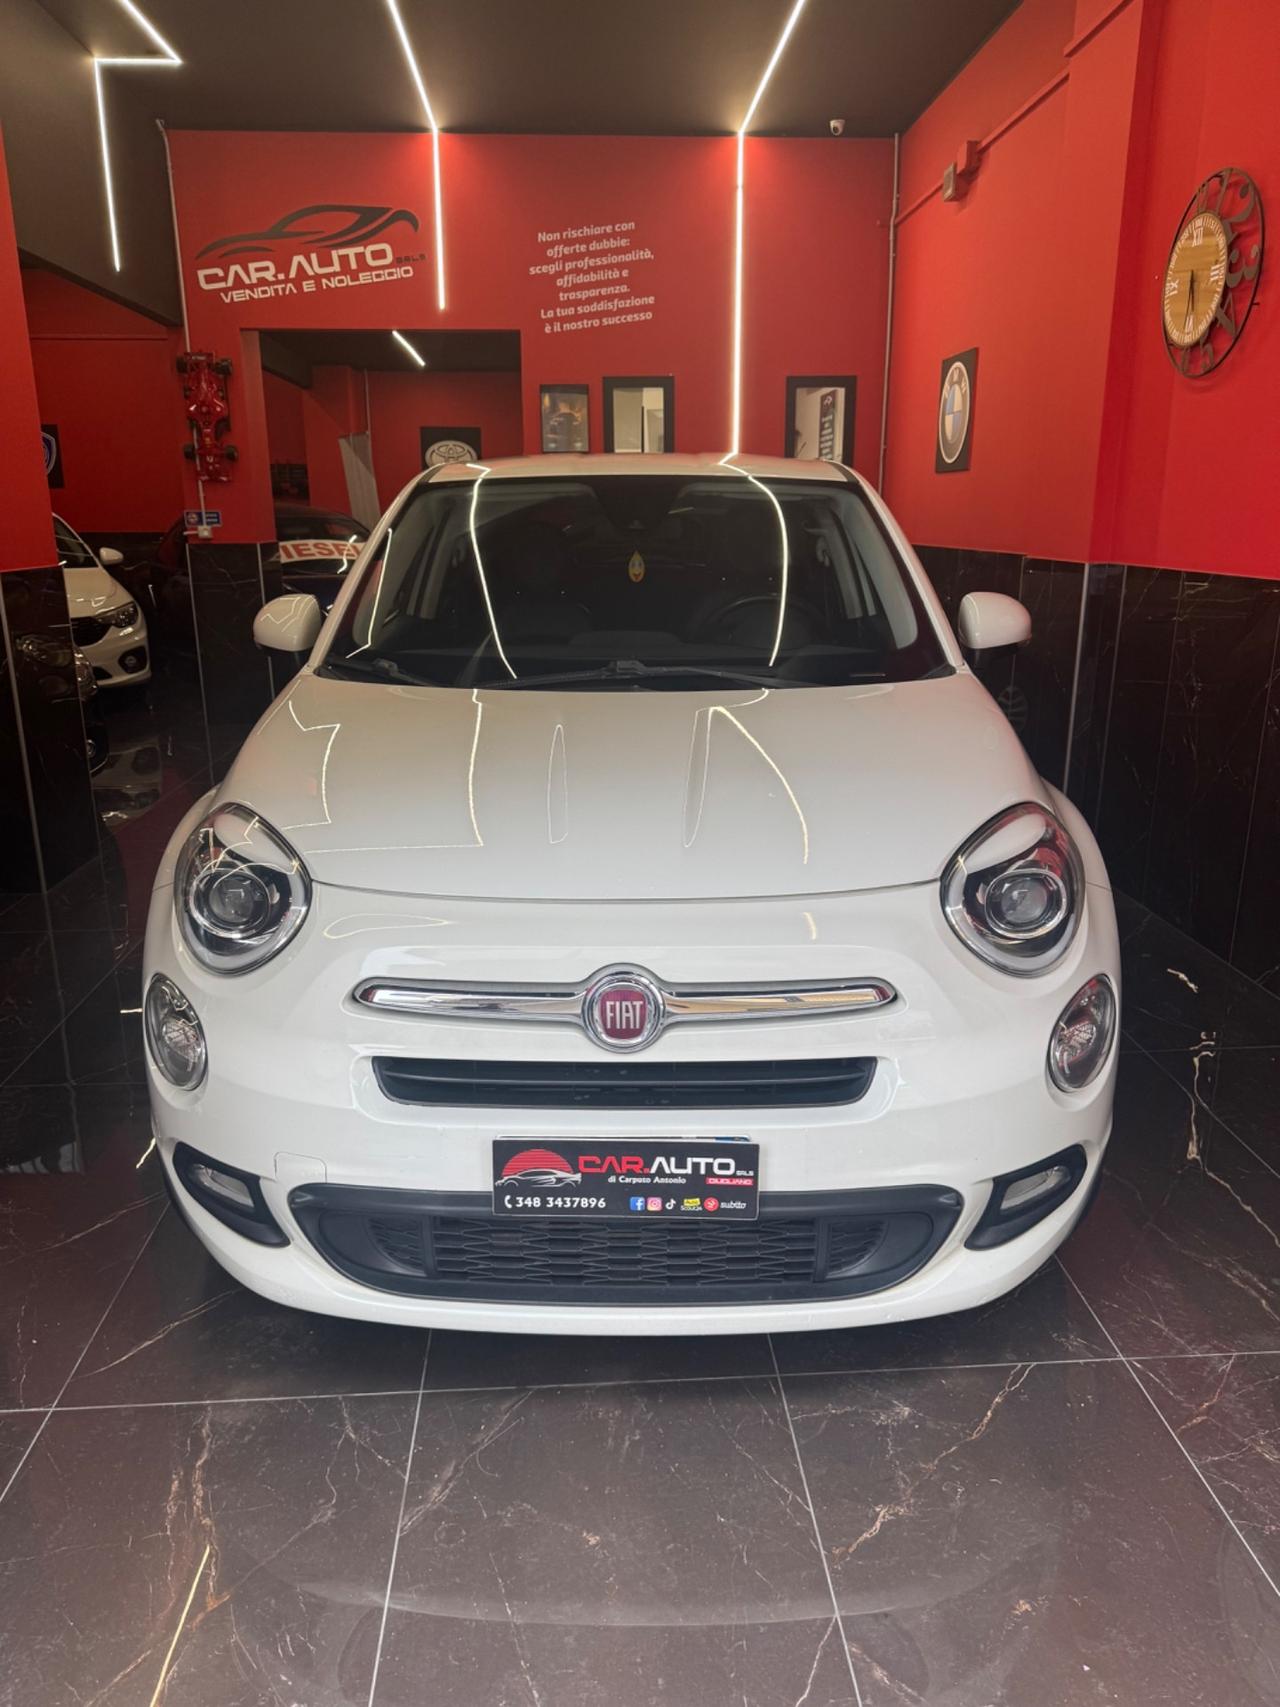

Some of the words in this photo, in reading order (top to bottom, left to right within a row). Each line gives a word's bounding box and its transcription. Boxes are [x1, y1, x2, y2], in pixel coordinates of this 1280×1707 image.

[537, 231, 560, 243] Non
[562, 225, 613, 239] rischiare
[614, 221, 635, 232] con
[546, 242, 587, 259] offerte
[588, 237, 631, 251] dubbie:
[197, 243, 393, 291] CAR.AUTO
[529, 260, 563, 276] scegli
[564, 248, 655, 273] professionalità,
[220, 284, 297, 304] VENDITA
[303, 280, 317, 293] E
[322, 265, 414, 290] NOLEGGIO
[556, 269, 620, 288] affidabilità
[621, 269, 629, 278] e
[559, 284, 631, 302] trasparenza.
[540, 308, 554, 319] La
[556, 304, 575, 316] tua
[577, 295, 656, 315] soddisfazione
[544, 322, 552, 334] è
[553, 320, 562, 333] il
[563, 316, 600, 332] nostro
[601, 310, 654, 327] successo
[605, 1000, 644, 1030] FIAT
[578, 1155, 736, 1175] CAR.AUTO
[608, 1175, 617, 1184] di
[653, 1176, 687, 1185] Antonio
[516, 1196, 542, 1208] 348
[546, 1197, 607, 1209] 3437896
